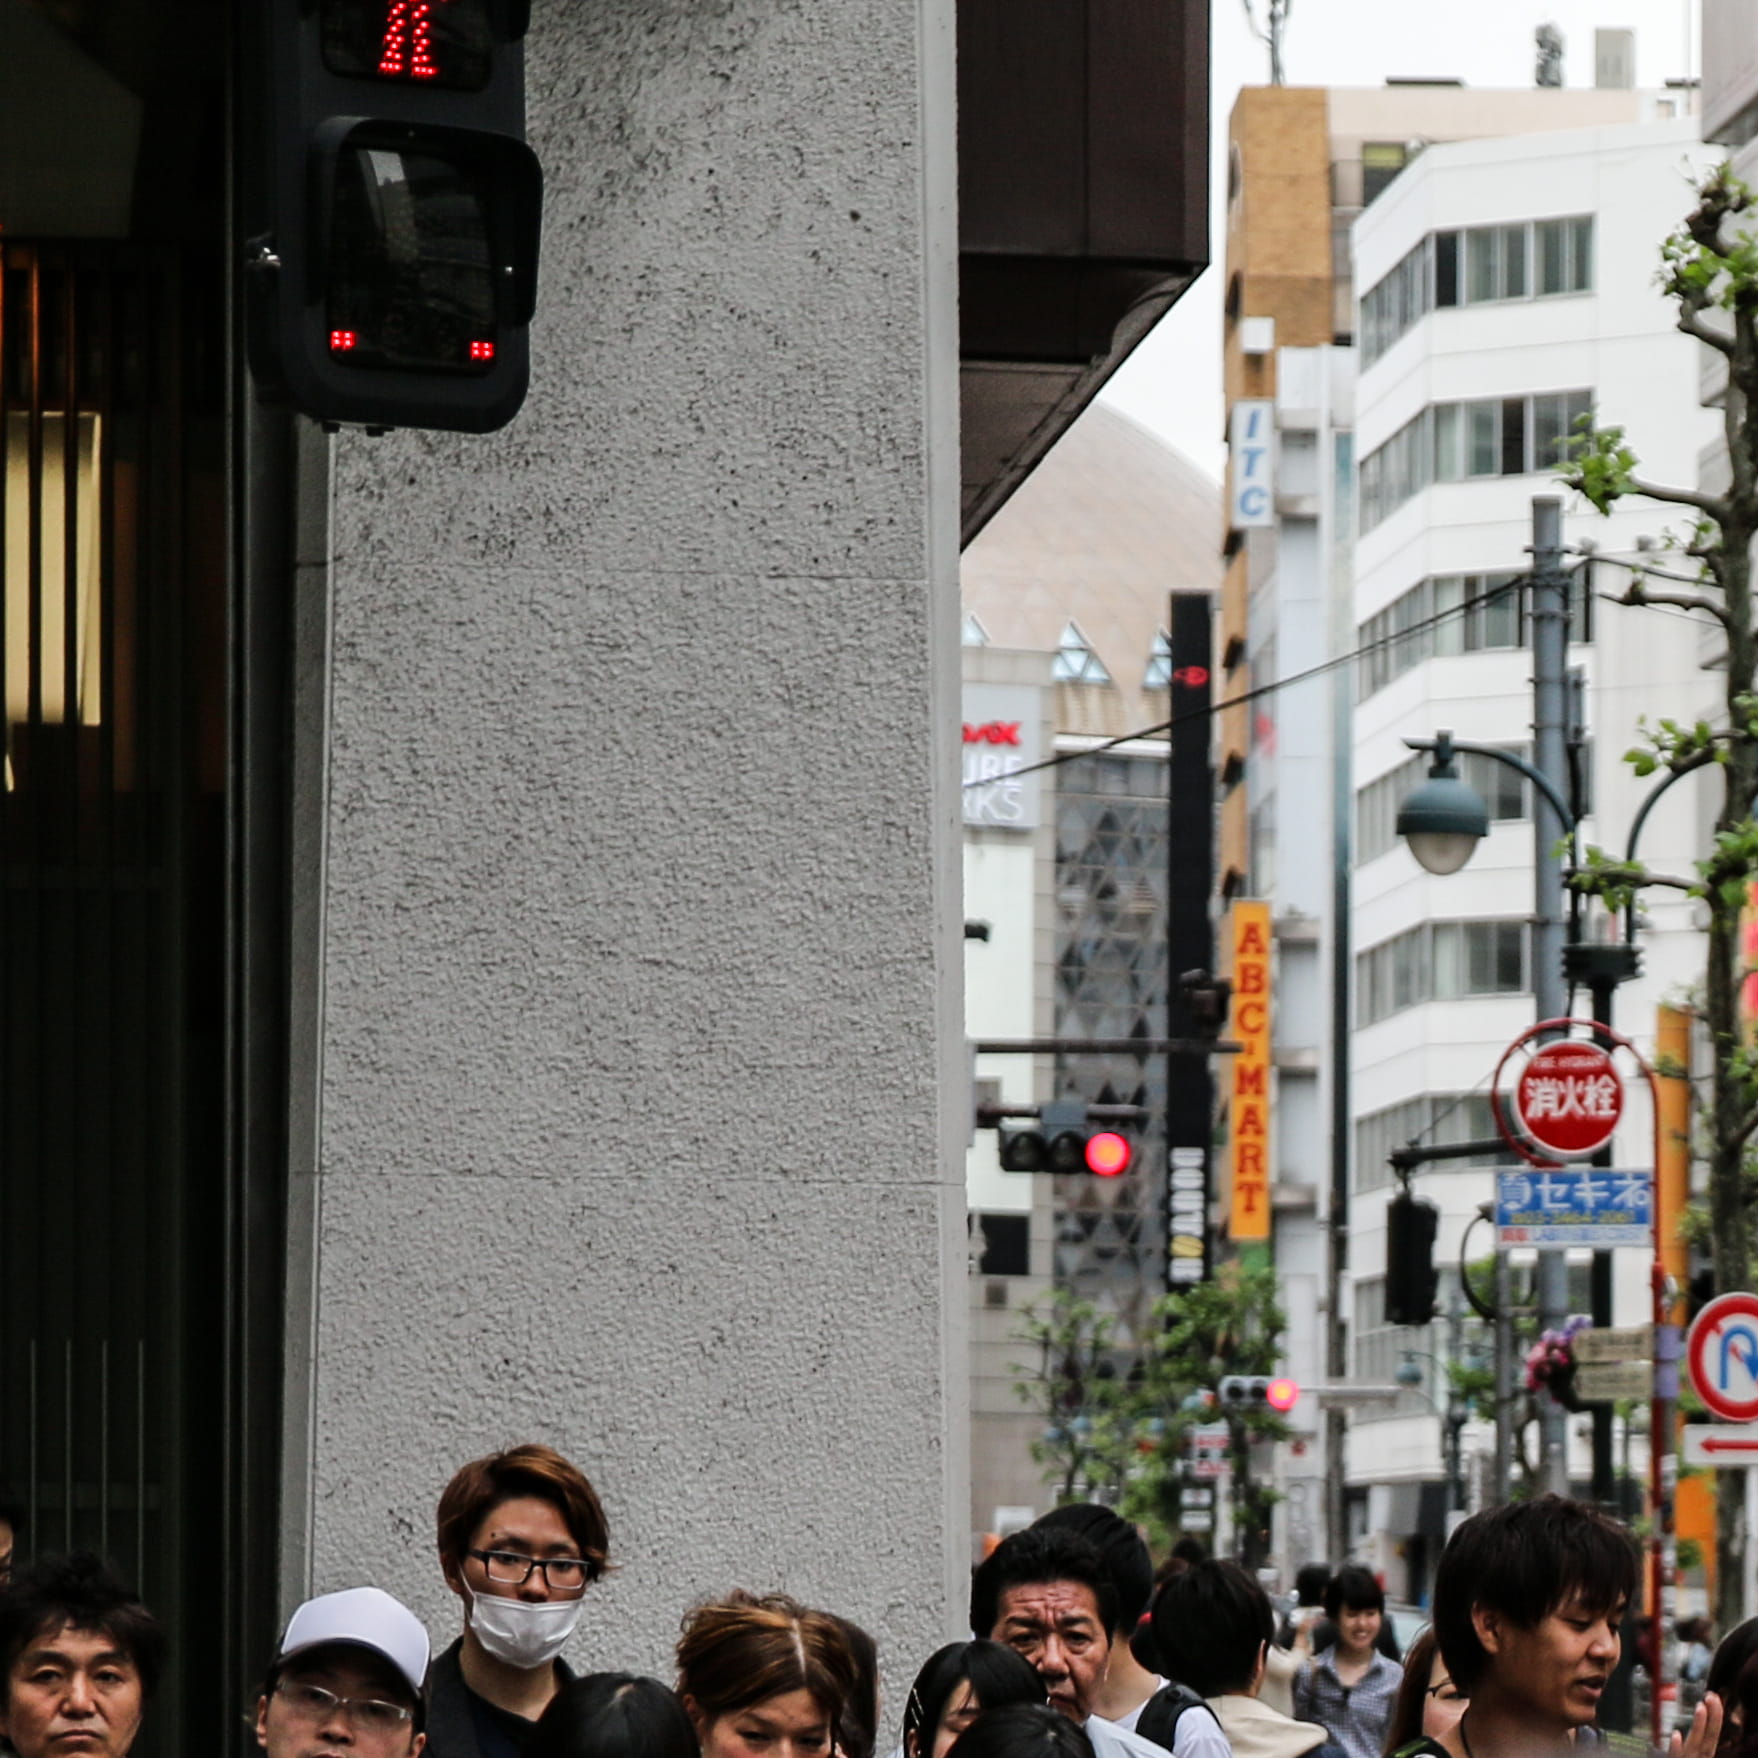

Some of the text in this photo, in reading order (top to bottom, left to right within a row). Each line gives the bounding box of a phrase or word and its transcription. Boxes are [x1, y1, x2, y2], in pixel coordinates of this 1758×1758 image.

[1239, 408, 1269, 517] ITC
[1525, 1074, 1618, 1119] 消火栓
